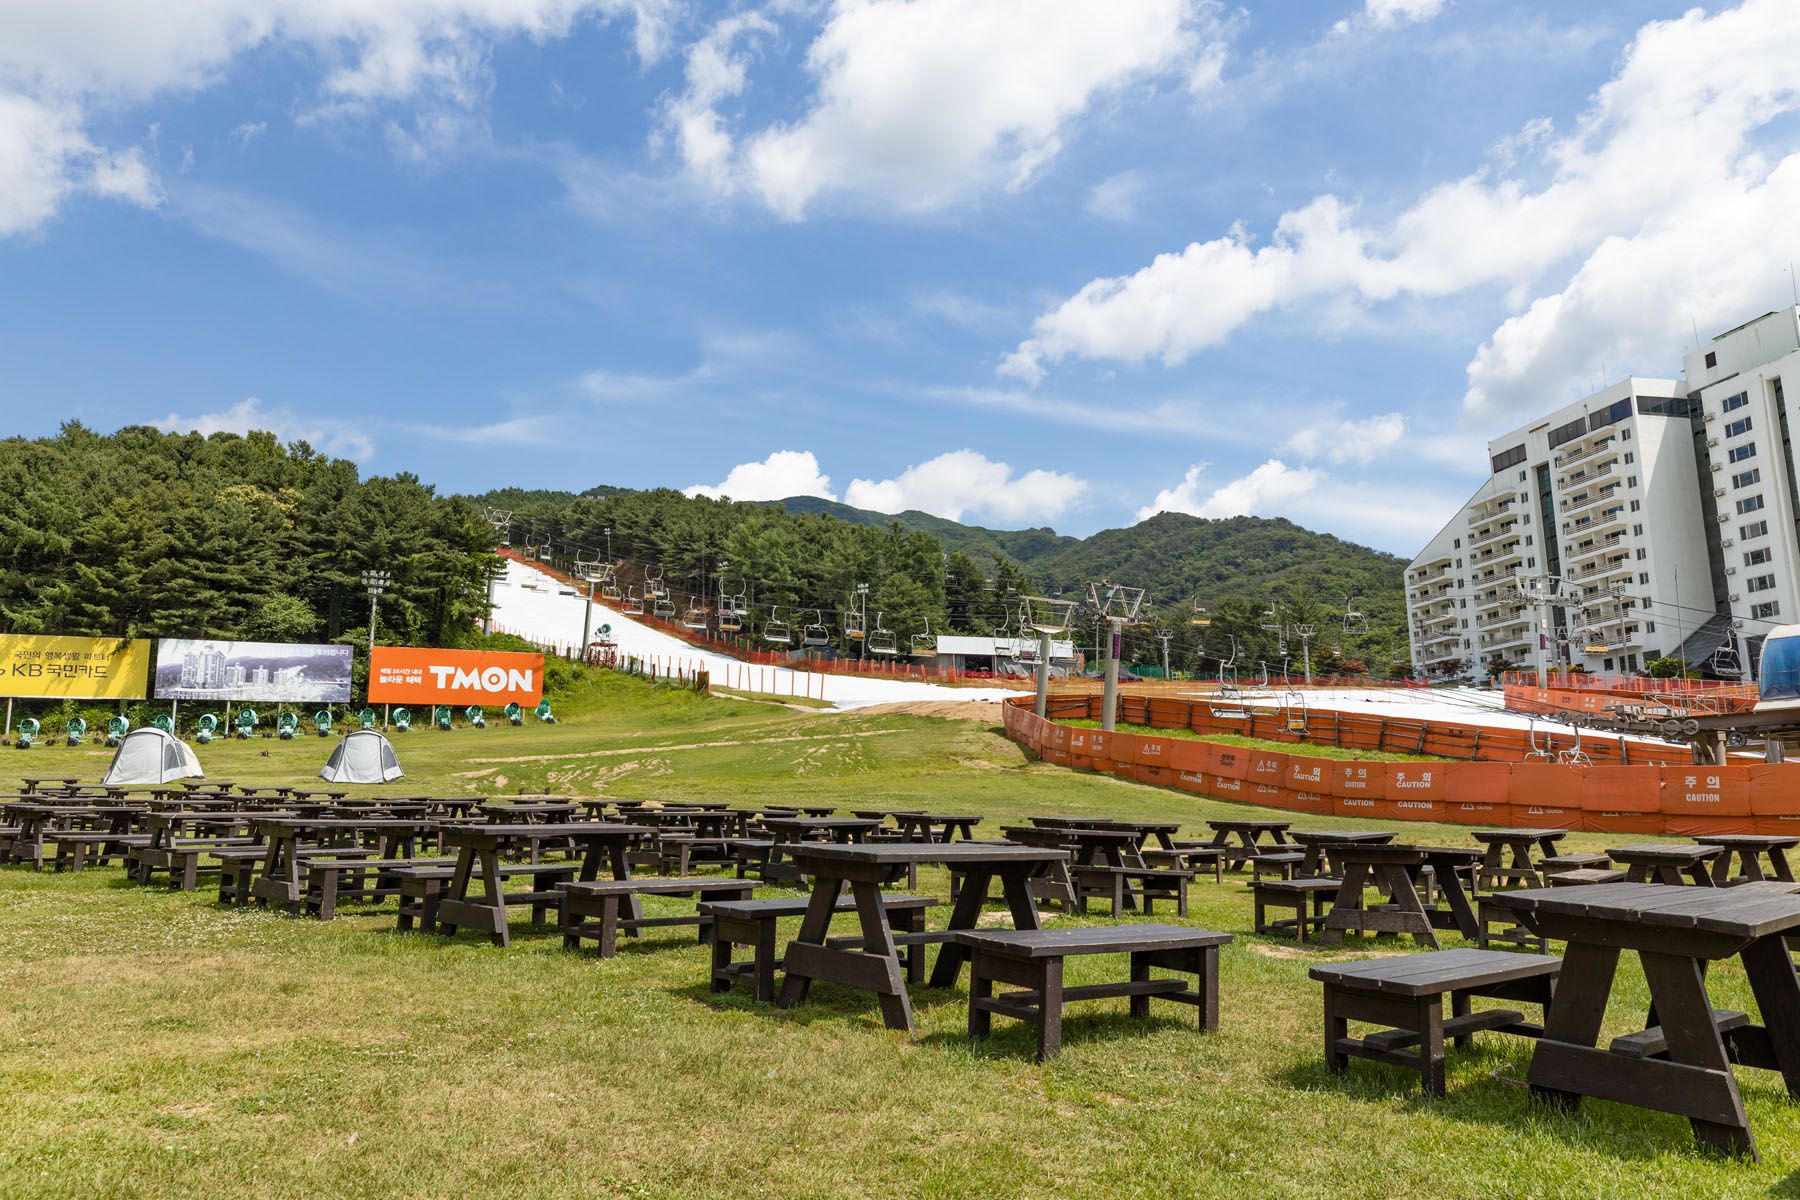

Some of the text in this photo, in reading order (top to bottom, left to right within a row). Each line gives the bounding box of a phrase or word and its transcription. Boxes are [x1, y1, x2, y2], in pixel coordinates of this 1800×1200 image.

[15, 650, 111, 662] 국민의 행복생활 파트너
[12, 663, 108, 679] KB 국민카드
[379, 675, 404, 684] 놀라운
[428, 665, 533, 693] TMON
[1293, 772, 1320, 782] CAUTION
[1216, 782, 1240, 791] CAUTION
[1345, 781, 1366, 789] CAUTION
[1686, 794, 1720, 802] CAUTION
[1343, 799, 1374, 807] CAUTION
[1397, 801, 1432, 809] CAUTION
